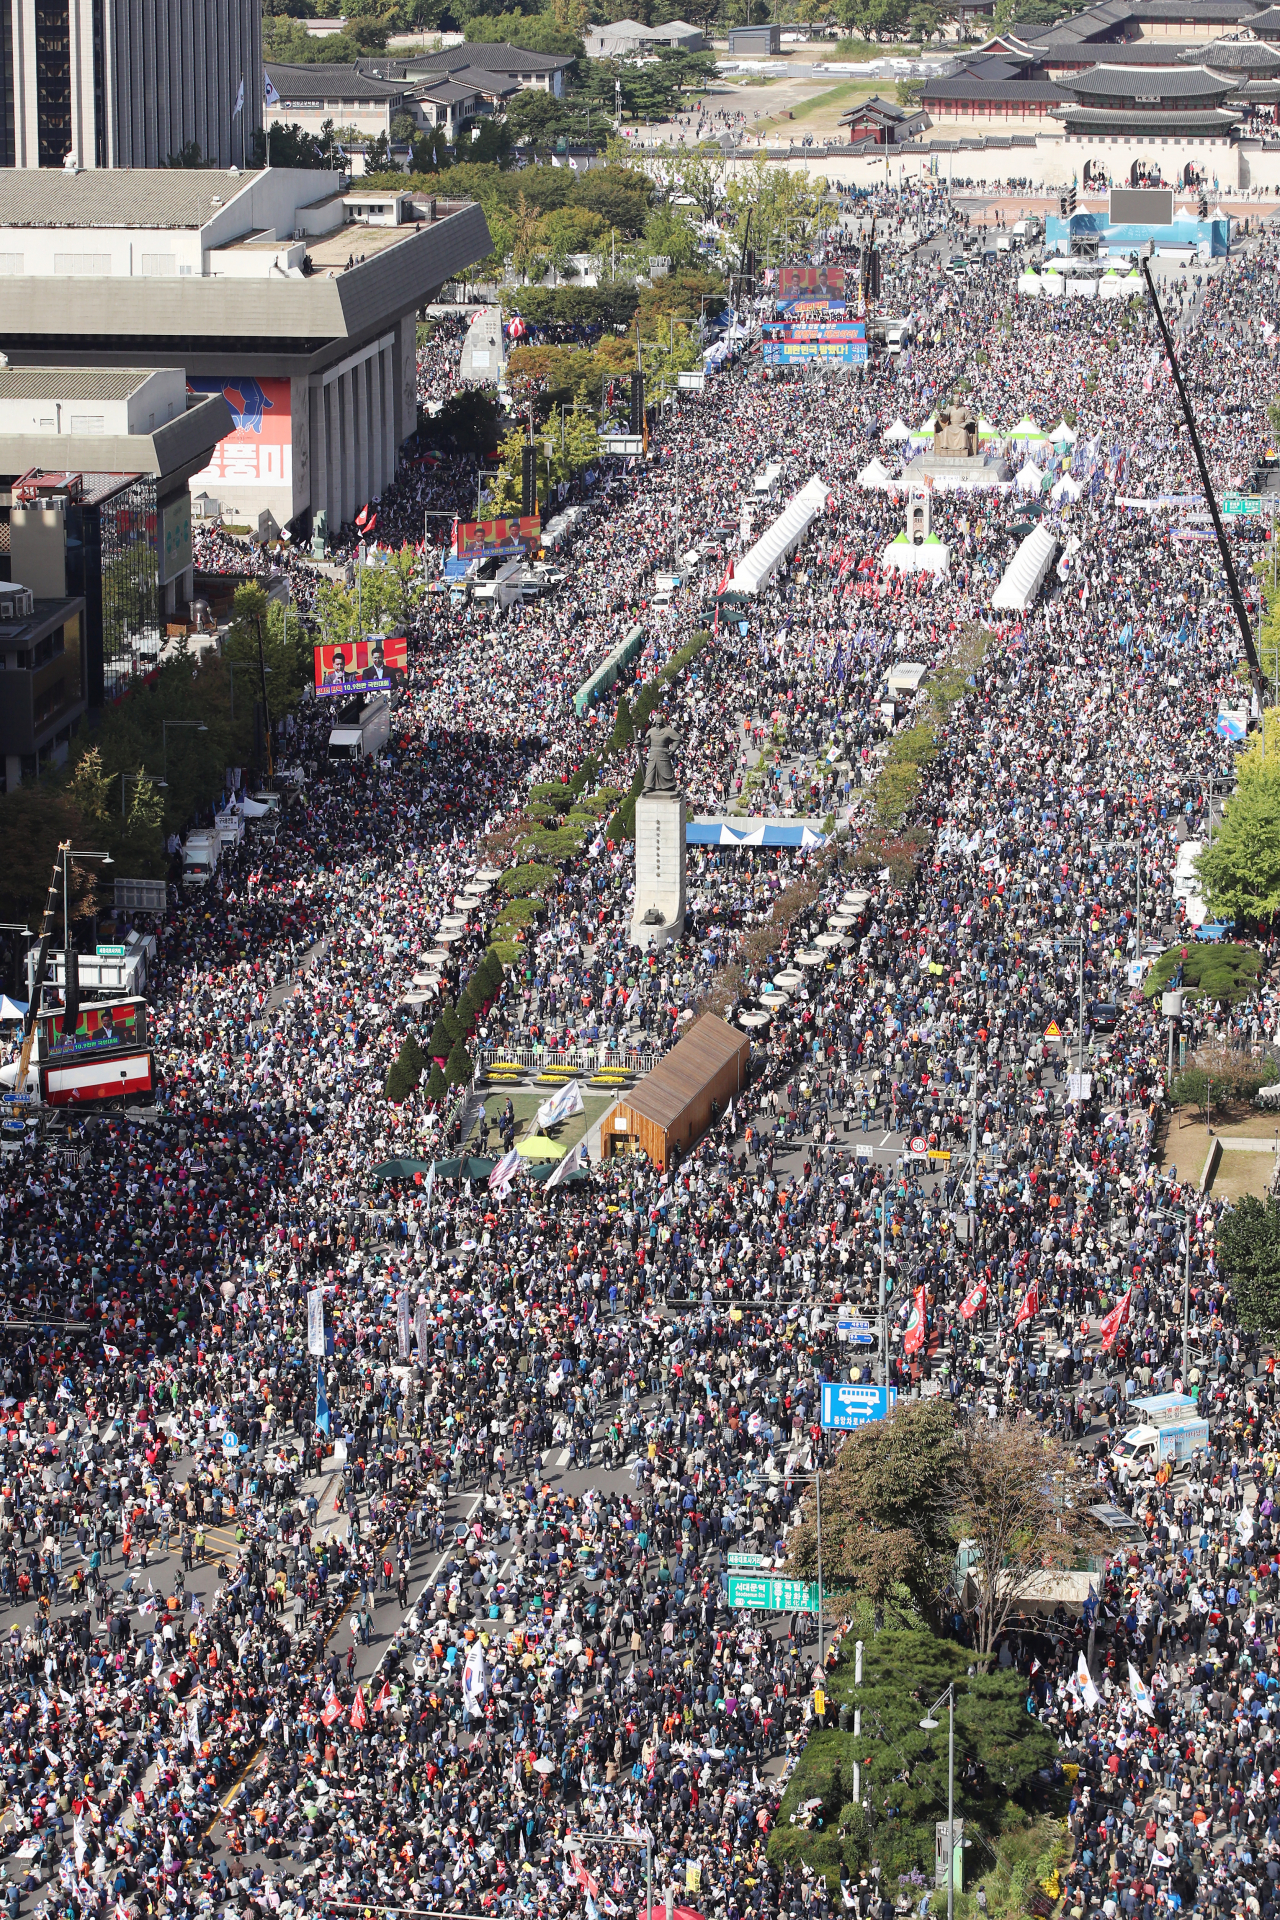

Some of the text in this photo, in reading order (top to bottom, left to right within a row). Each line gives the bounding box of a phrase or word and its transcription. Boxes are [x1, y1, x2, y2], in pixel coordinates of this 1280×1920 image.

[784, 345, 817, 354] 대한민국
[368, 680, 390, 688] 국민대회
[912, 1141, 924, 1149] 50
[735, 1582, 766, 1592] 서대문역
[784, 1592, 810, 1600] 광화문
